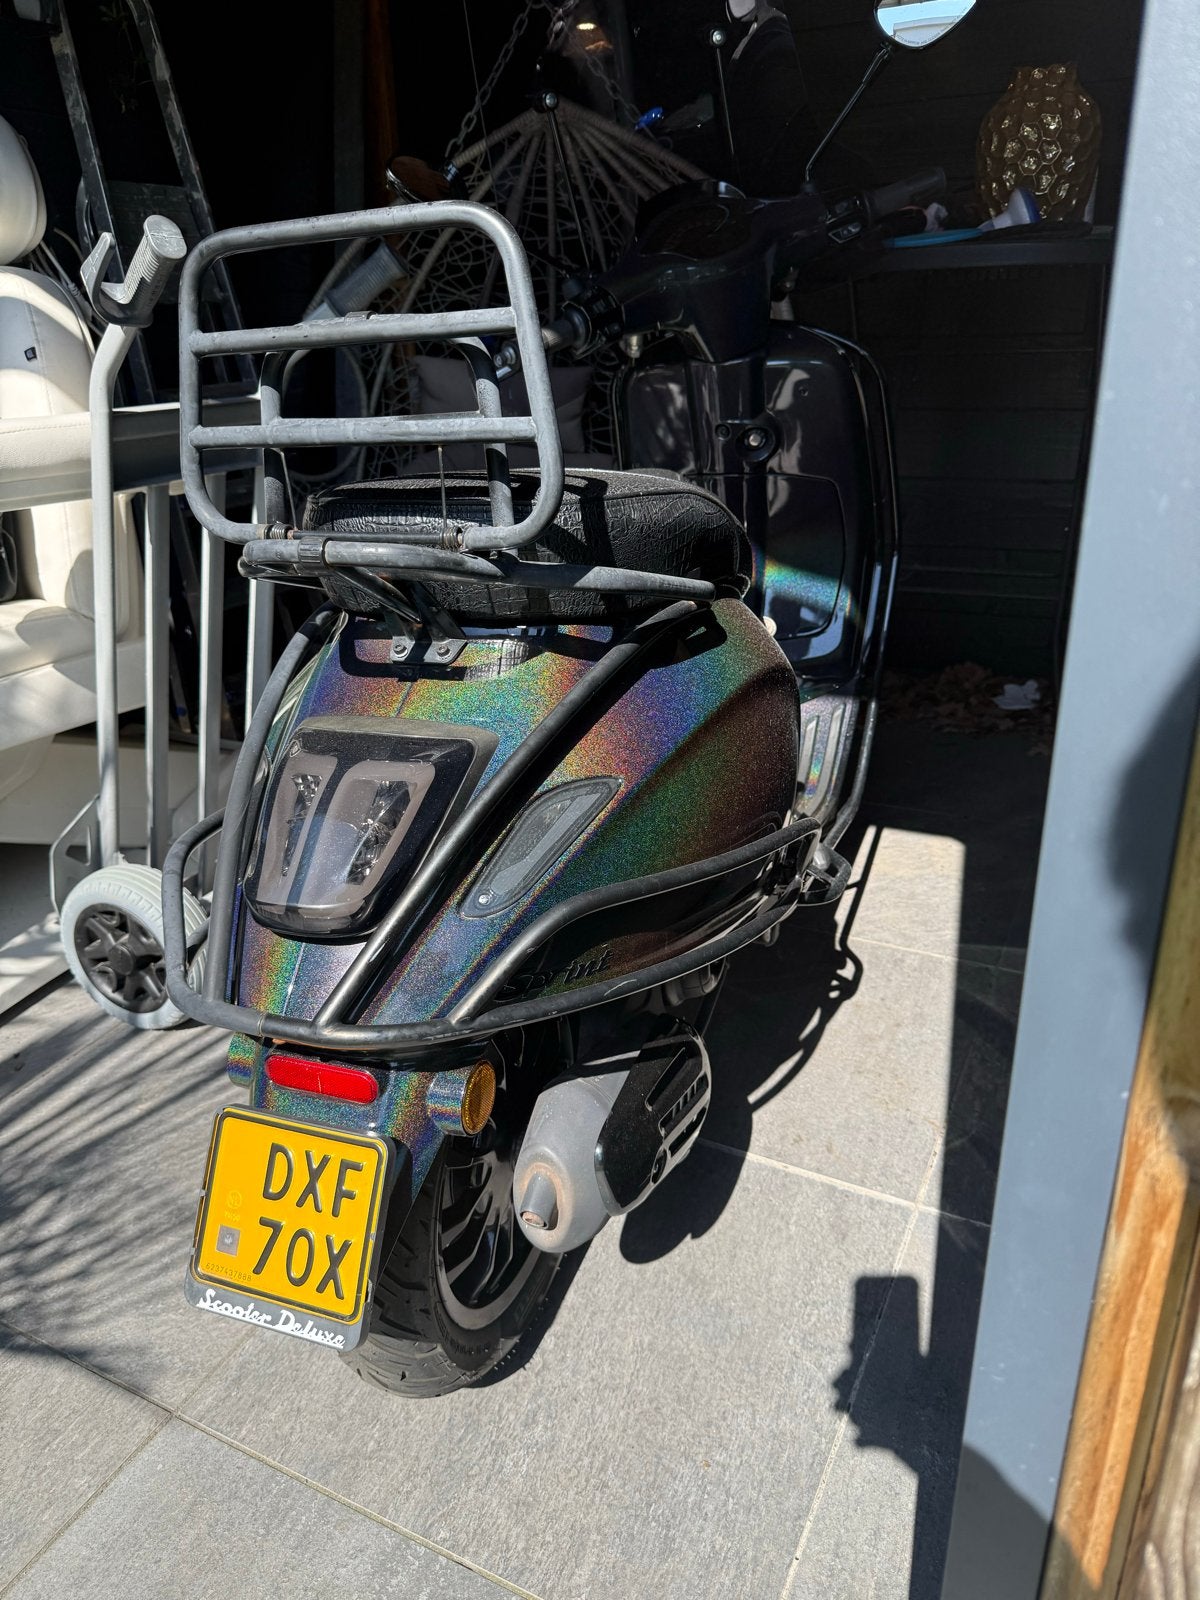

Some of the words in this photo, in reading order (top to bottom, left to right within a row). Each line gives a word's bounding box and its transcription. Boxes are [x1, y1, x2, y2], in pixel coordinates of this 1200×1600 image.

[262, 1142, 364, 1218] DXF
[252, 1216, 353, 1300] 70X
[197, 1288, 272, 1327] Scooter
[274, 1309, 346, 1349] Deluxe
